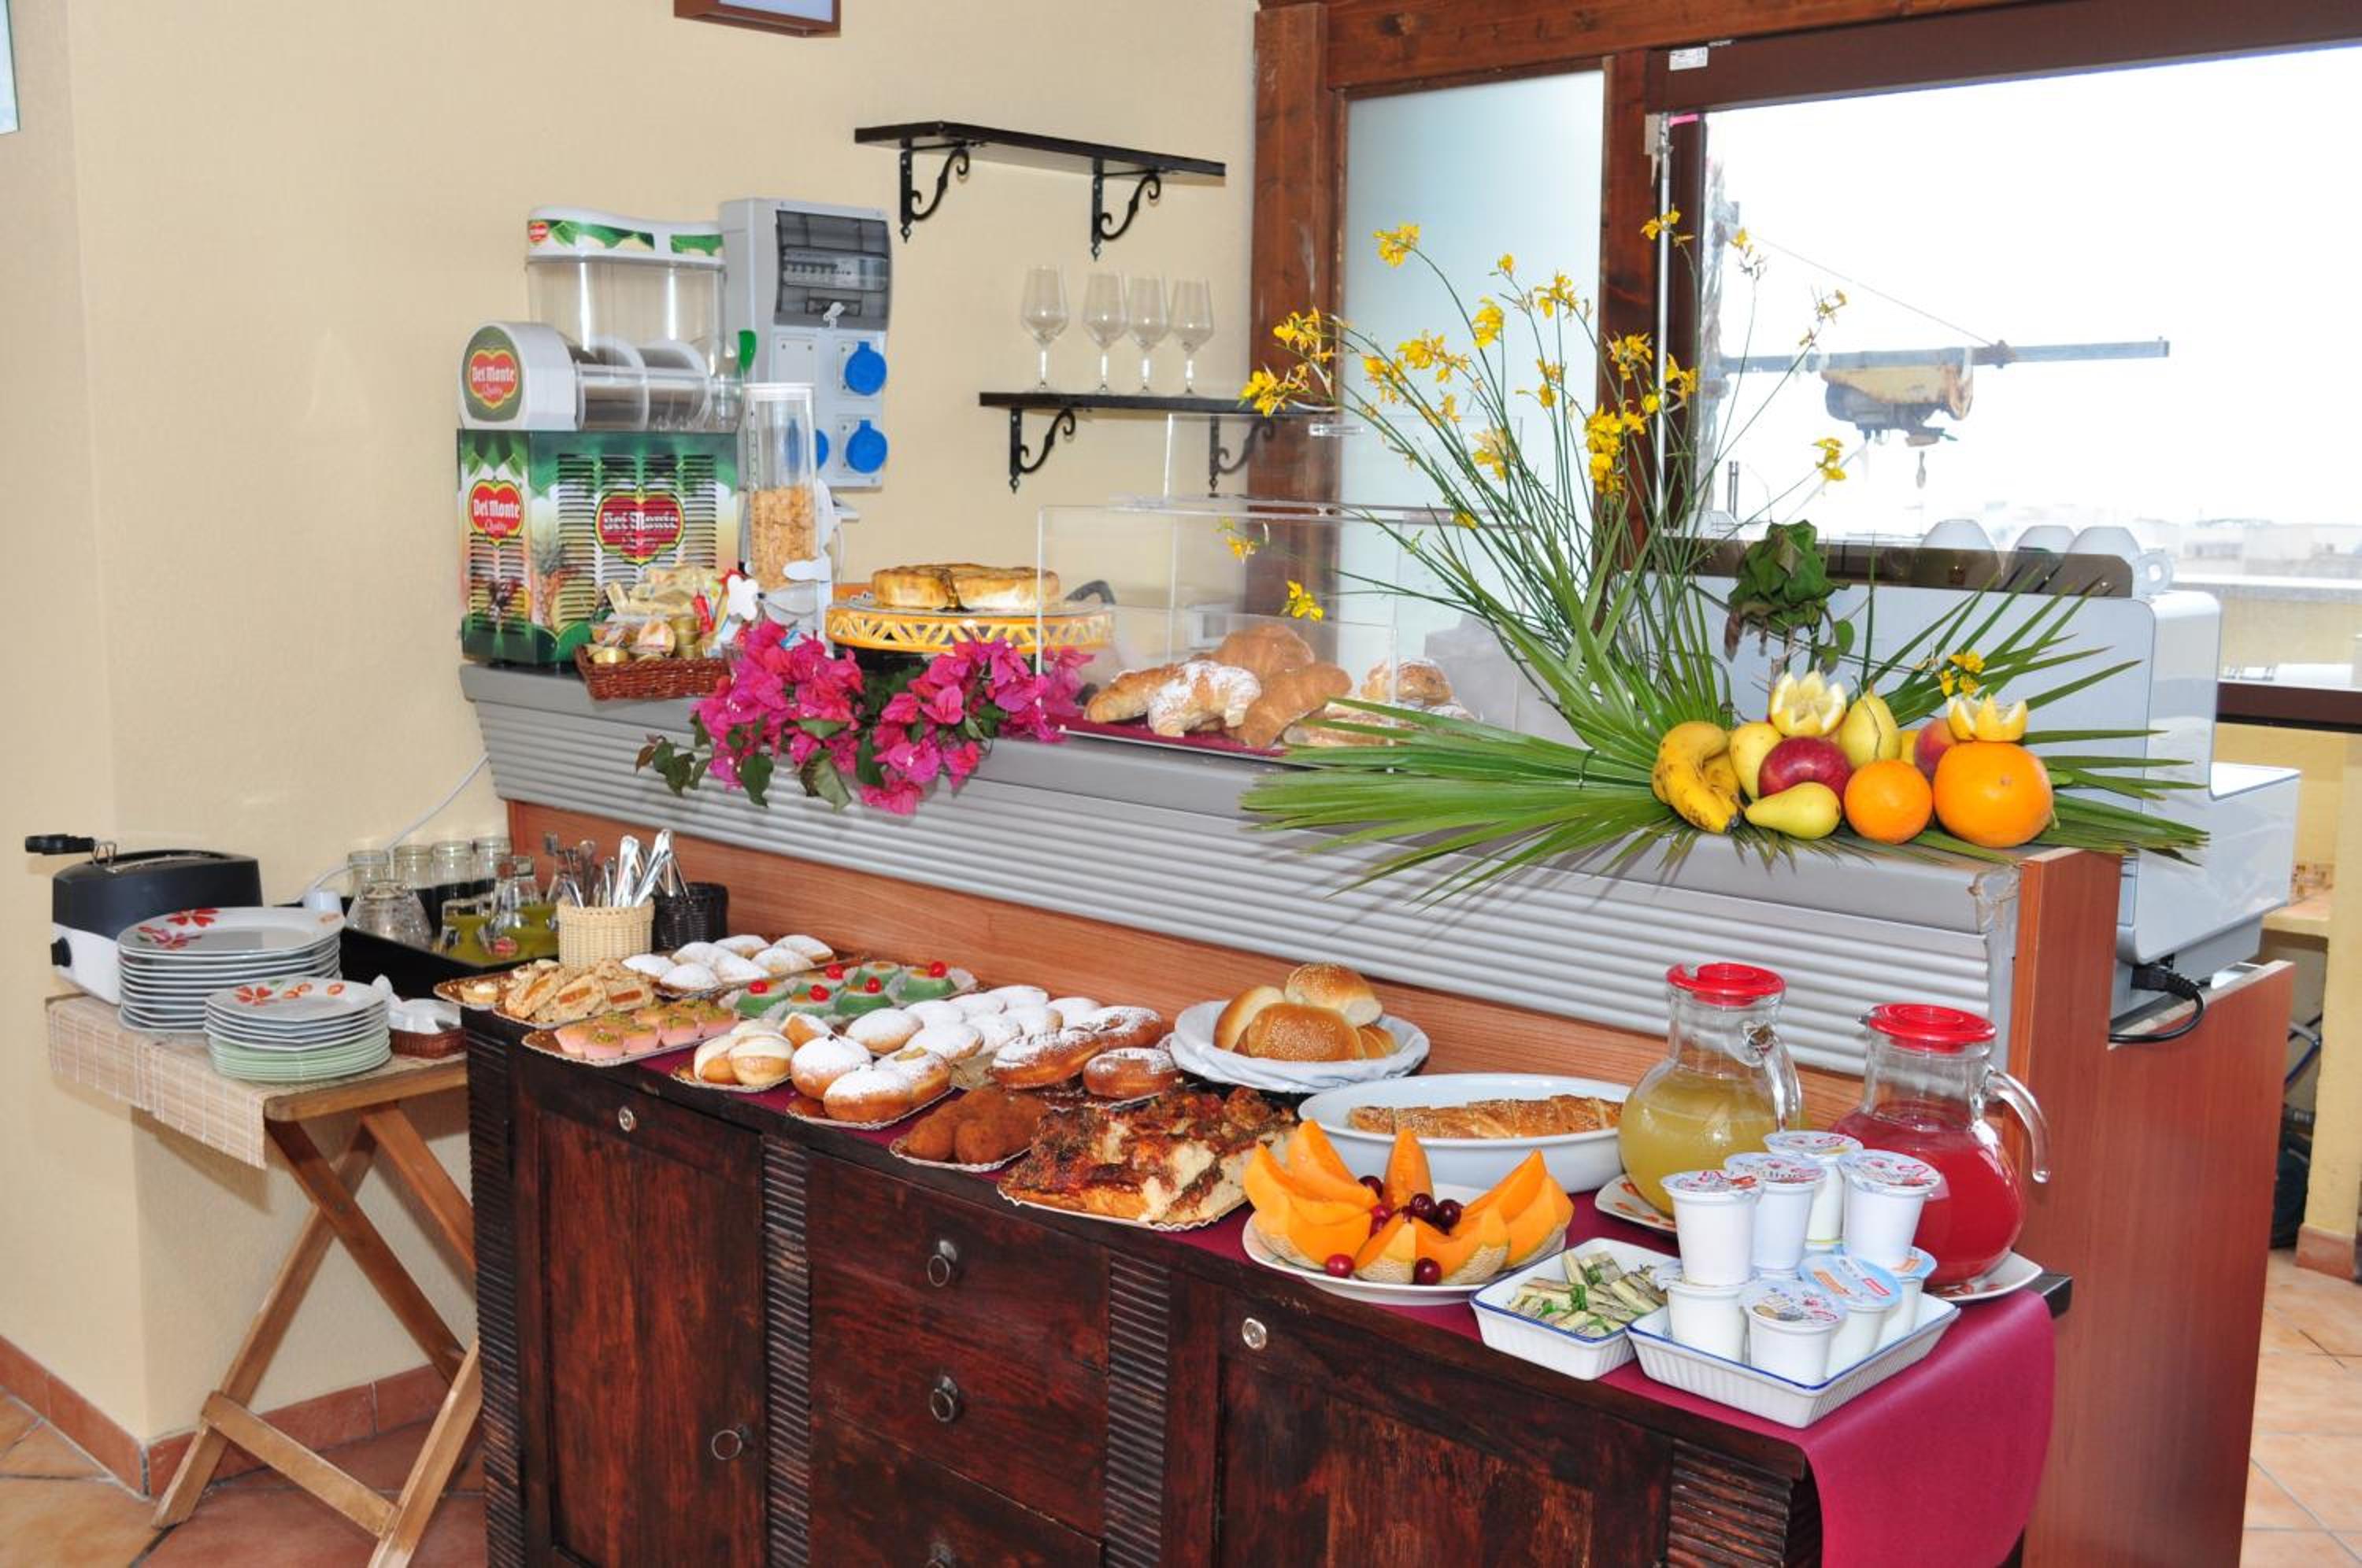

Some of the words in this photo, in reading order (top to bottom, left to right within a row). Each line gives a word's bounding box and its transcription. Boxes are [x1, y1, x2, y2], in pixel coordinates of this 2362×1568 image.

[472, 366, 486, 383] Del
[487, 365, 516, 383] Monte
[473, 499, 488, 517] Del
[489, 500, 520, 520] Monte
